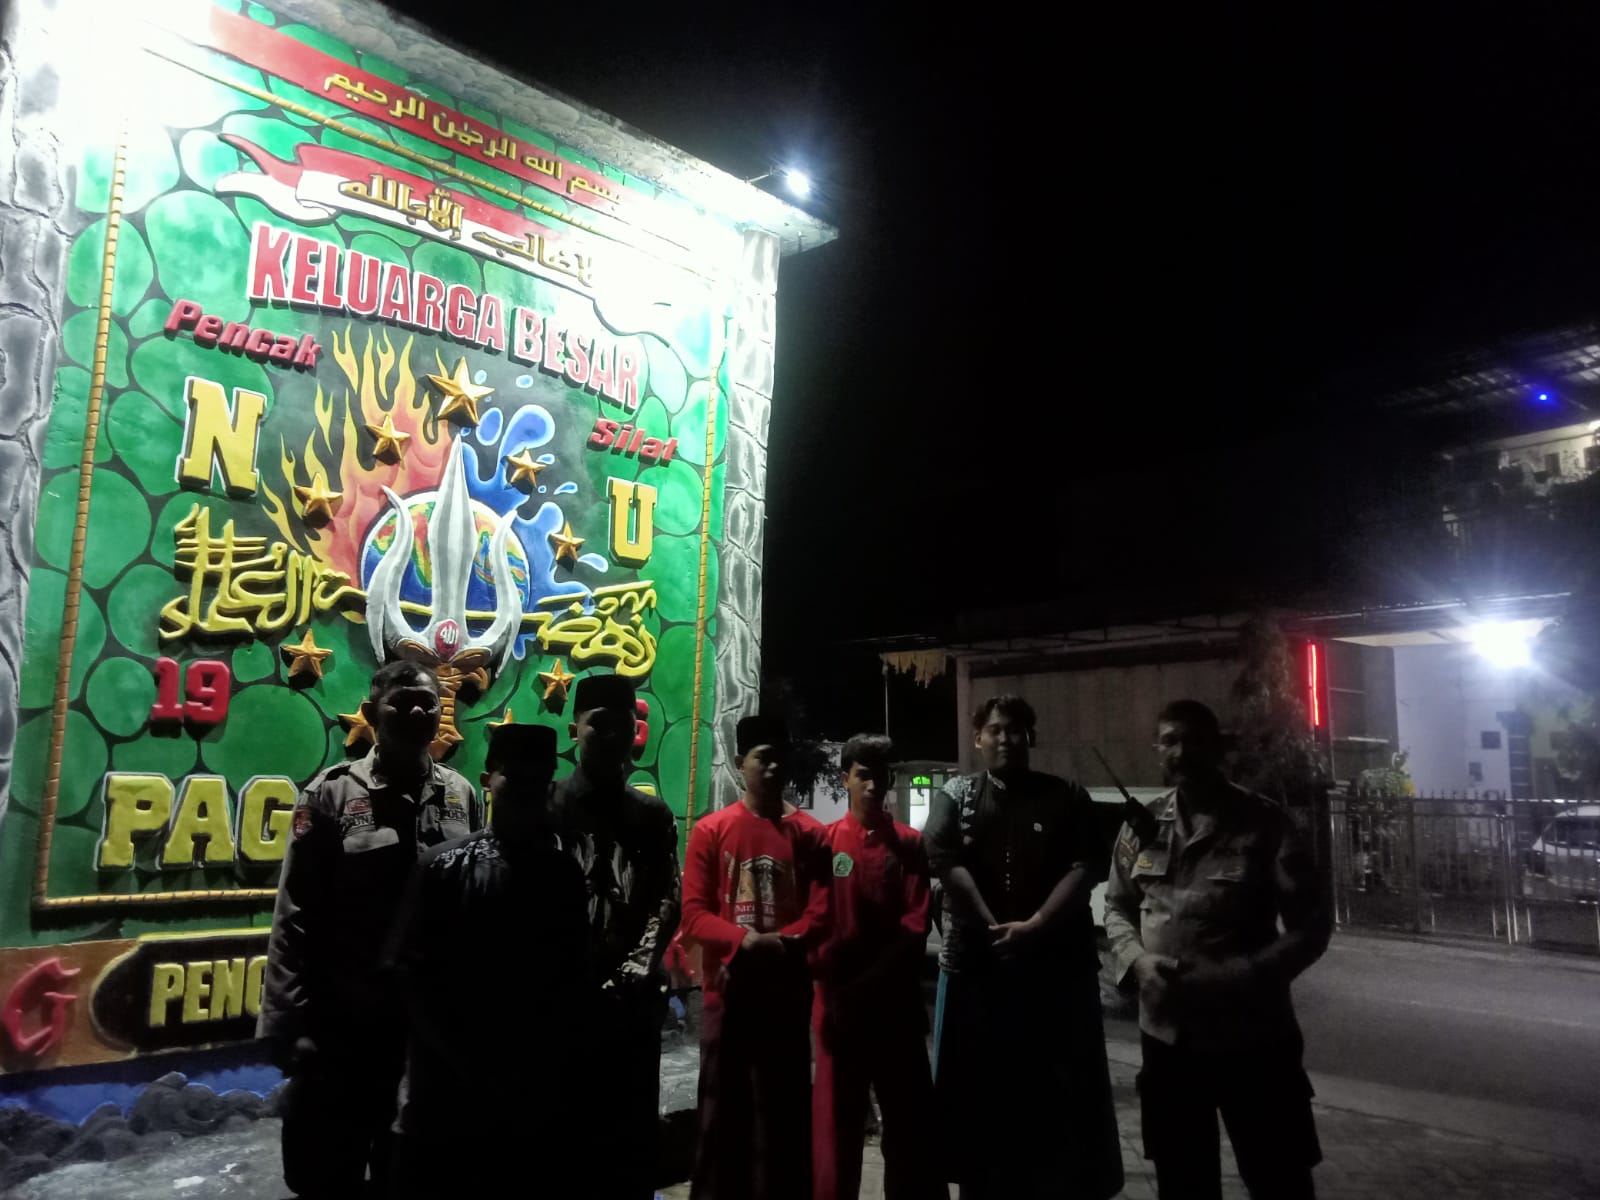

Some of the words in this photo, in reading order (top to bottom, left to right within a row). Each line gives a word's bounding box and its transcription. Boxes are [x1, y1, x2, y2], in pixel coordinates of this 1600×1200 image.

[323, 72, 426, 120] الرحيم
[521, 153, 563, 181] الله
[165, 299, 323, 370] Pencak
[251, 222, 504, 351] KELUARGA
[514, 306, 641, 412] BESAR
[175, 376, 267, 498] N
[587, 417, 678, 468] Silat
[606, 476, 657, 569] U
[150, 655, 231, 726] 19
[96, 771, 298, 870] PAG
